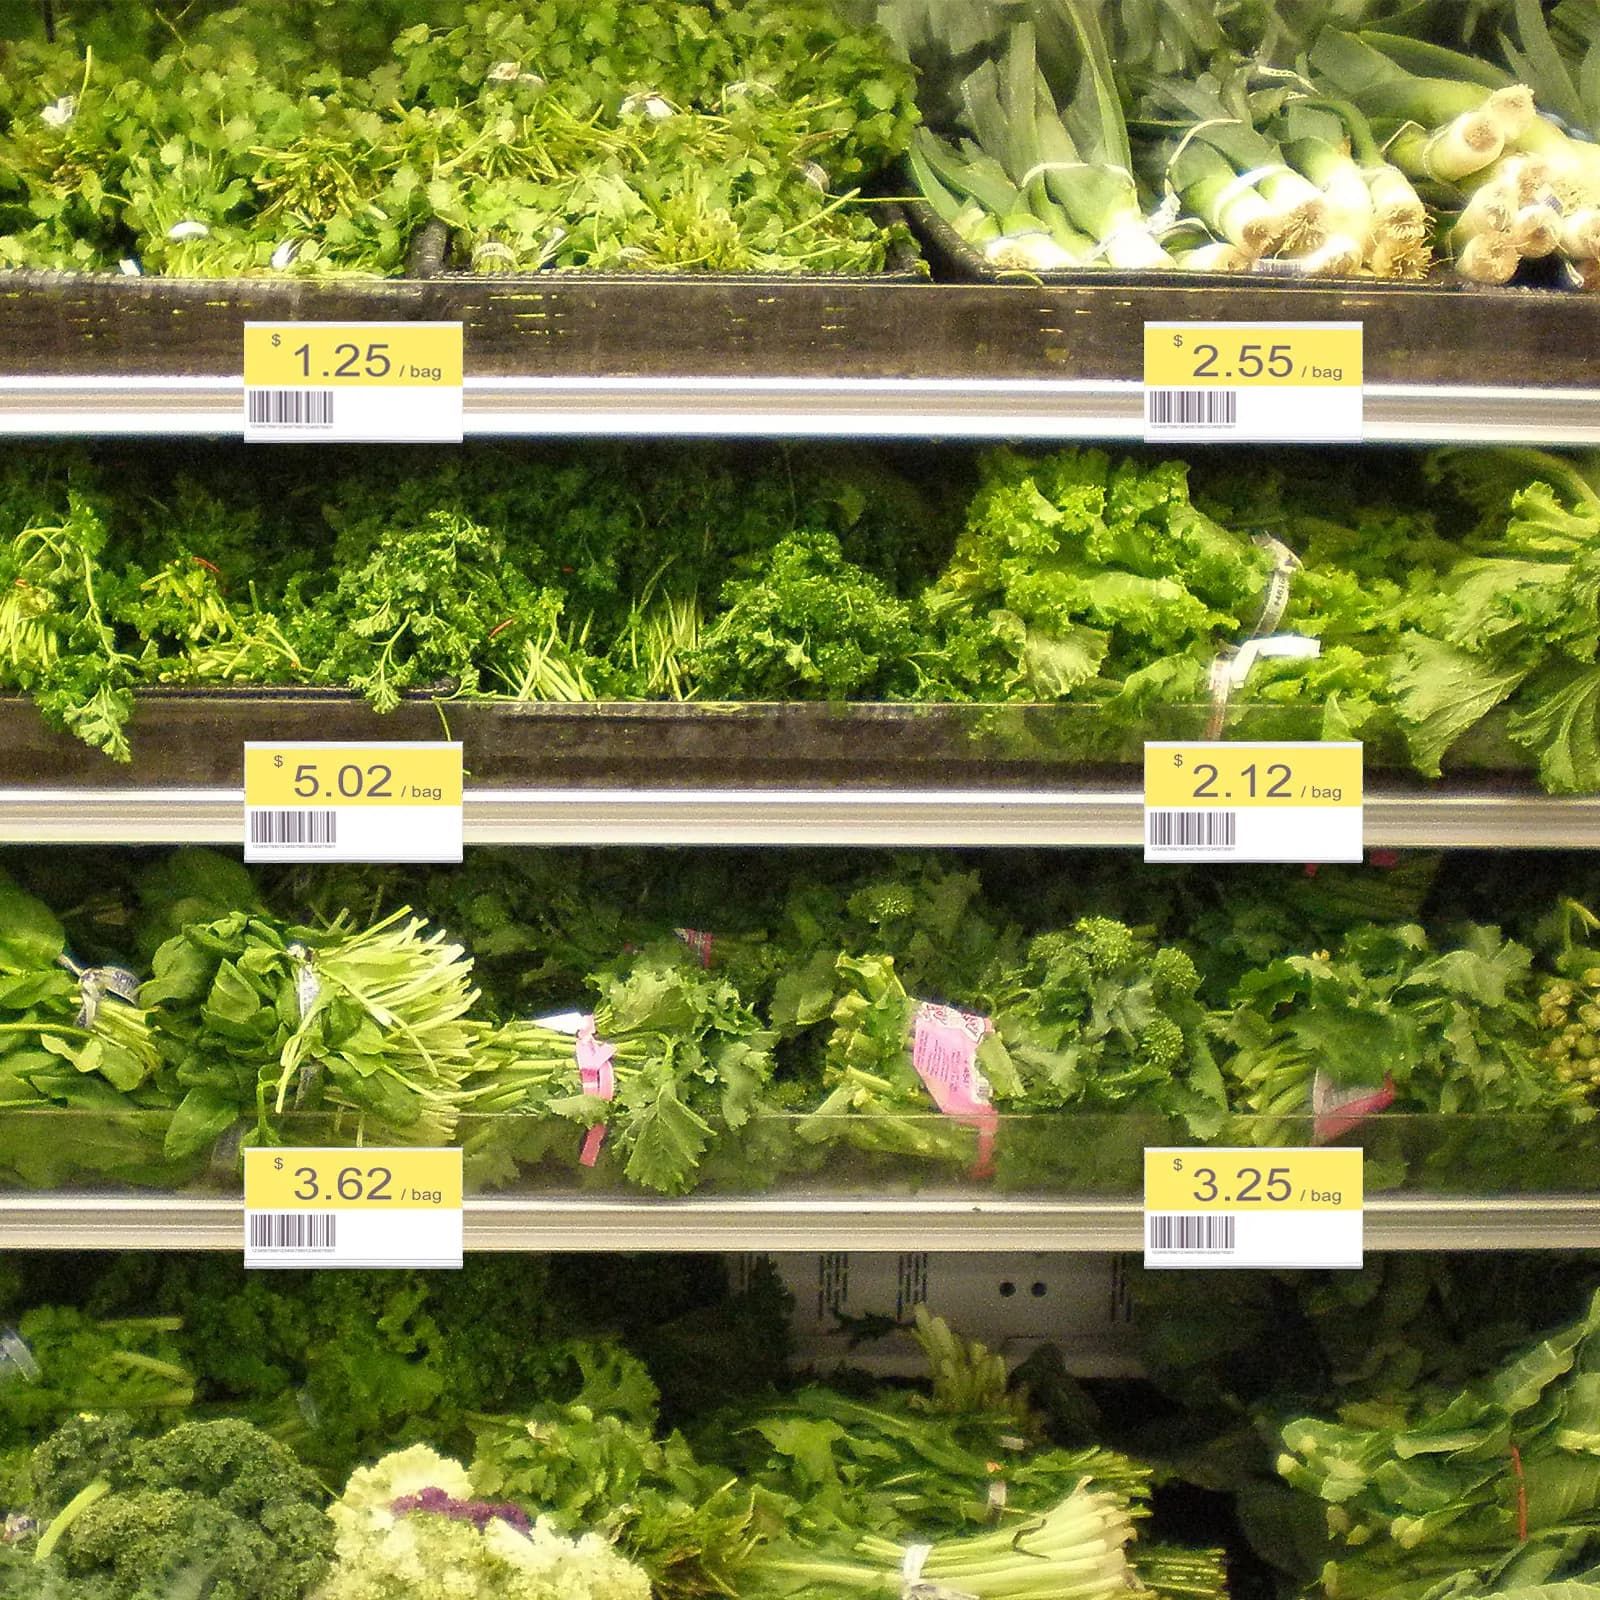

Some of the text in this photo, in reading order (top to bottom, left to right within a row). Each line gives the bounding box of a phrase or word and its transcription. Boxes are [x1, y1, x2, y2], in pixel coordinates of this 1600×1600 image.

[271, 333, 281, 347] $
[294, 343, 391, 378] 1.25
[410, 365, 442, 381] bag
[1173, 334, 1183, 348] $
[1193, 344, 1294, 378] 2.55
[1312, 366, 1343, 382] bag
[273, 754, 284, 769] $
[294, 764, 393, 798] 5.02
[411, 785, 442, 801] bag
[1173, 753, 1184, 769] $
[1192, 764, 1292, 798] 2.12
[1311, 785, 1342, 802] bag
[273, 1156, 284, 1171] $
[294, 1167, 392, 1201] 3.62
[411, 1188, 442, 1204] bag
[1173, 1158, 1183, 1172] $
[1193, 1167, 1292, 1202] 3.25
[1311, 1188, 1342, 1205] bag
